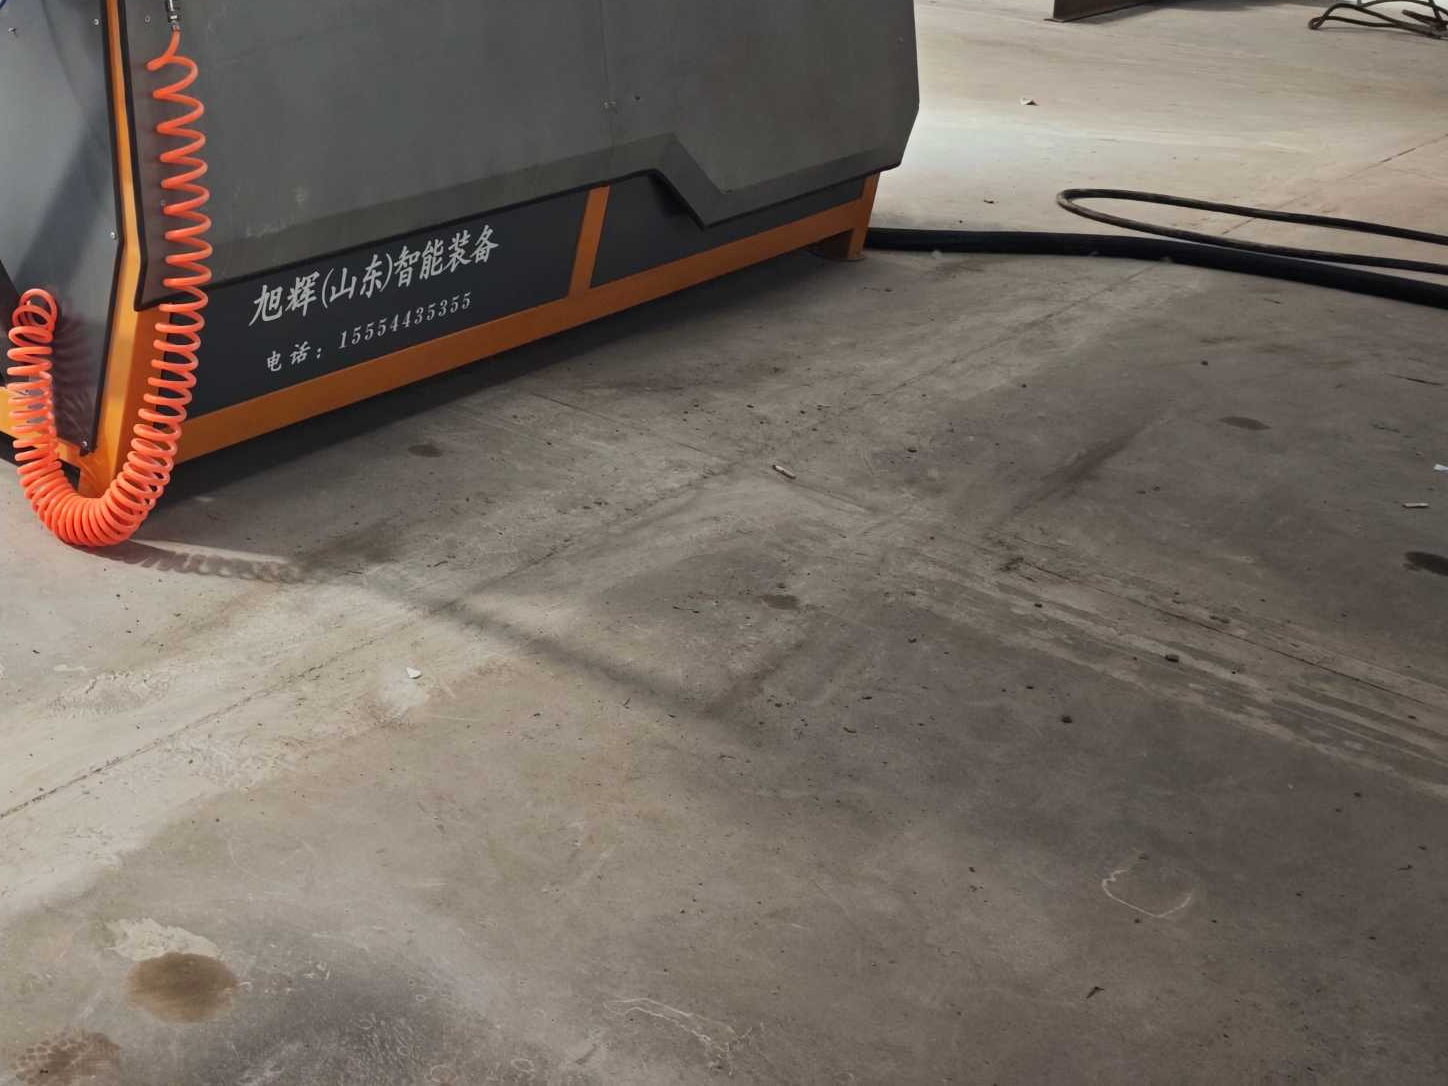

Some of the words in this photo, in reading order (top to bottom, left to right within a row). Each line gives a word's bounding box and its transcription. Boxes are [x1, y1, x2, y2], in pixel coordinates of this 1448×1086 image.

[249, 224, 499, 327] 旭辉(山东)智能装备
[338, 291, 472, 350] 15554435355
